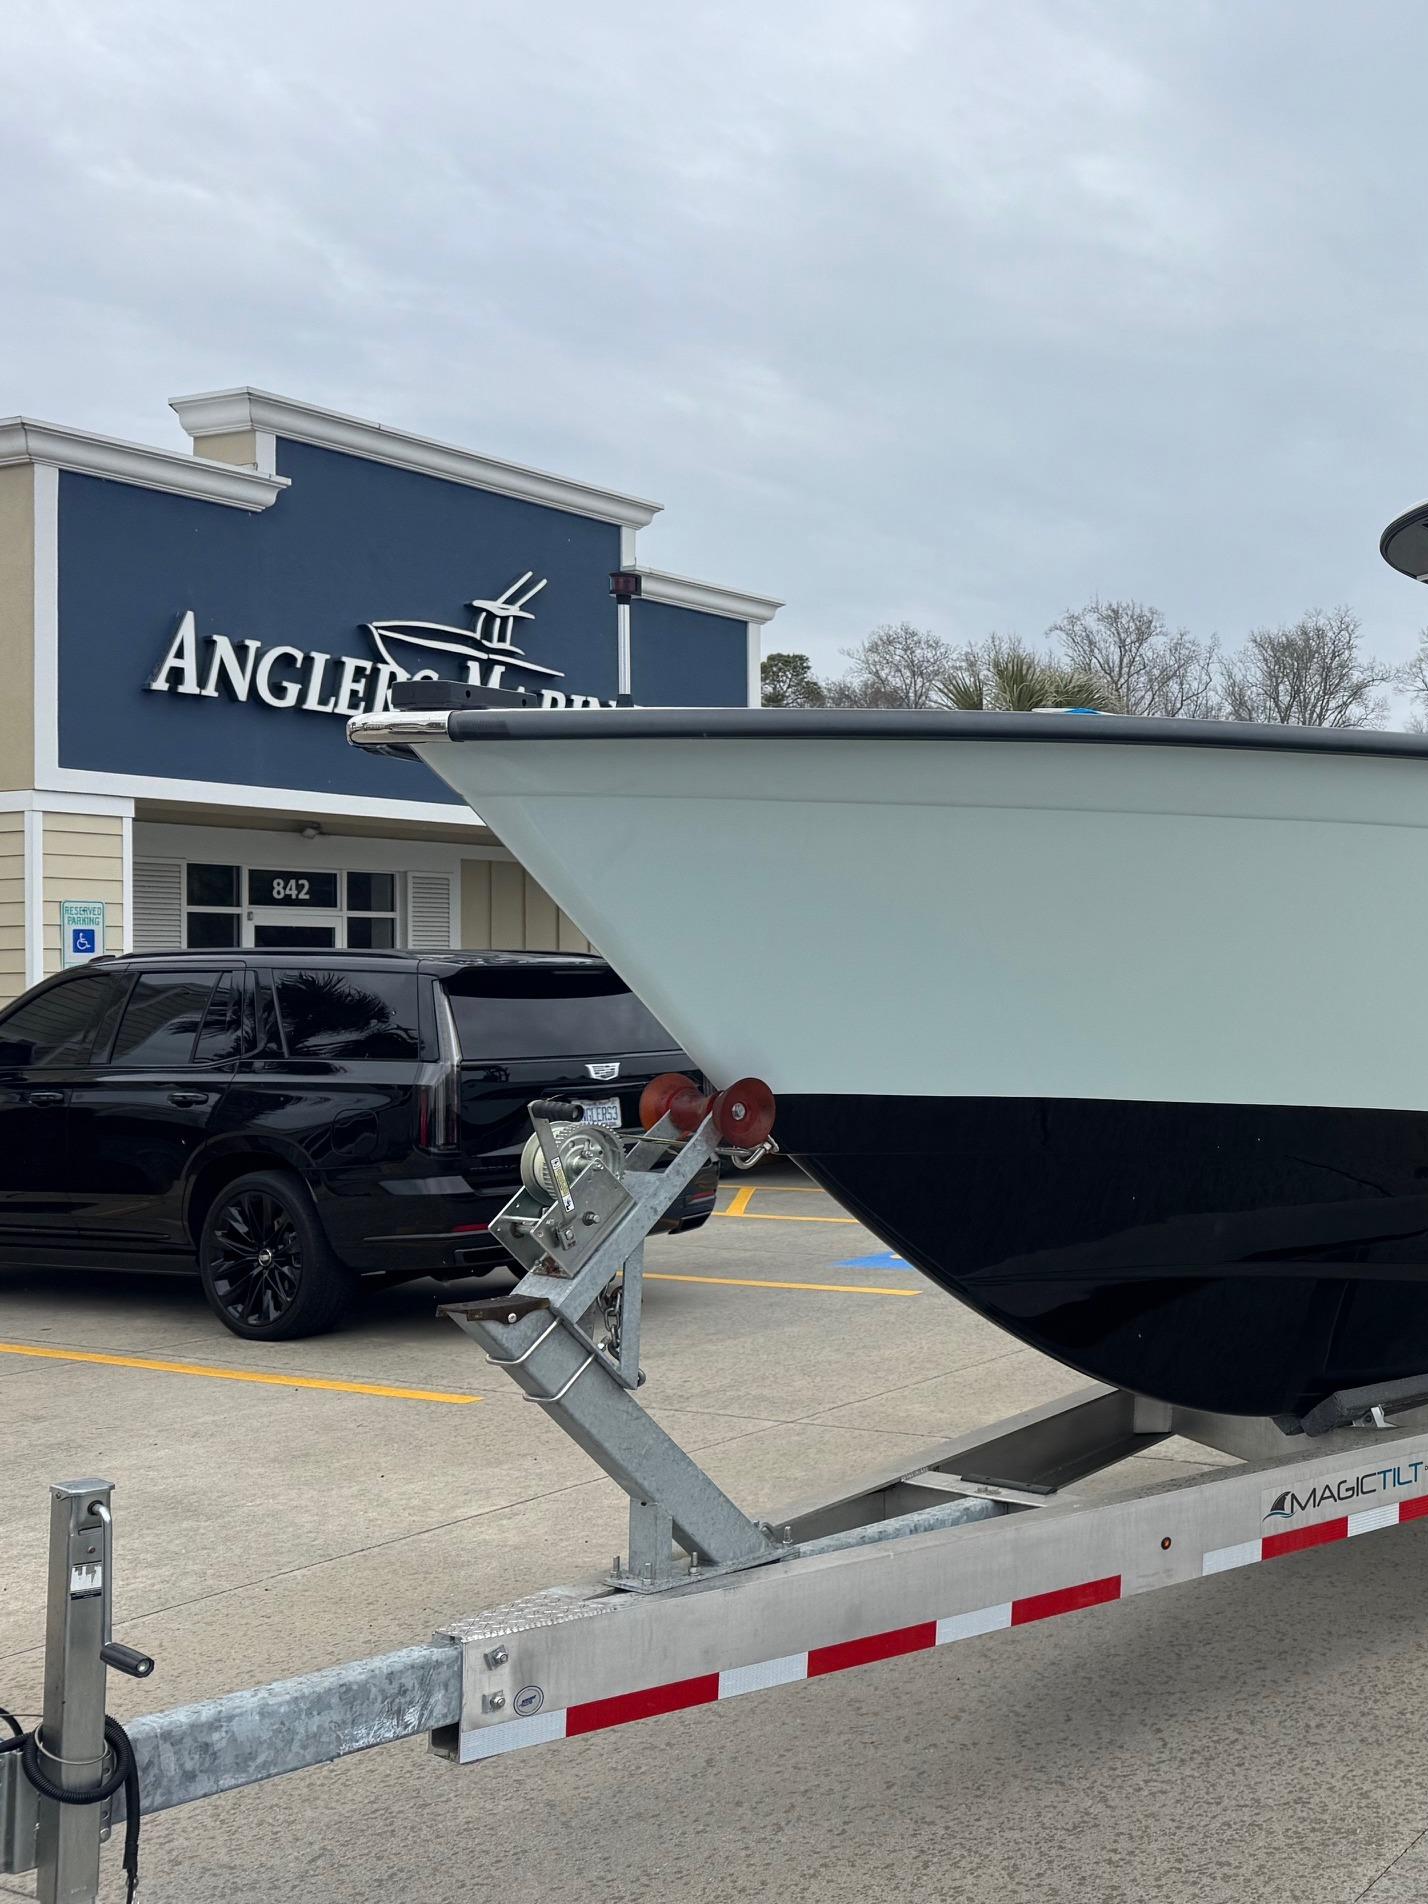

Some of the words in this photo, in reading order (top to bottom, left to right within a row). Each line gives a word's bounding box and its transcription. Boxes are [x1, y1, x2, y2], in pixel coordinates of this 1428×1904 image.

[272, 878, 310, 900] 842
[65, 906, 102, 916] RESERVED
[67, 916, 100, 926] PARKING
[582, 1105, 618, 1122] NGLERS3
